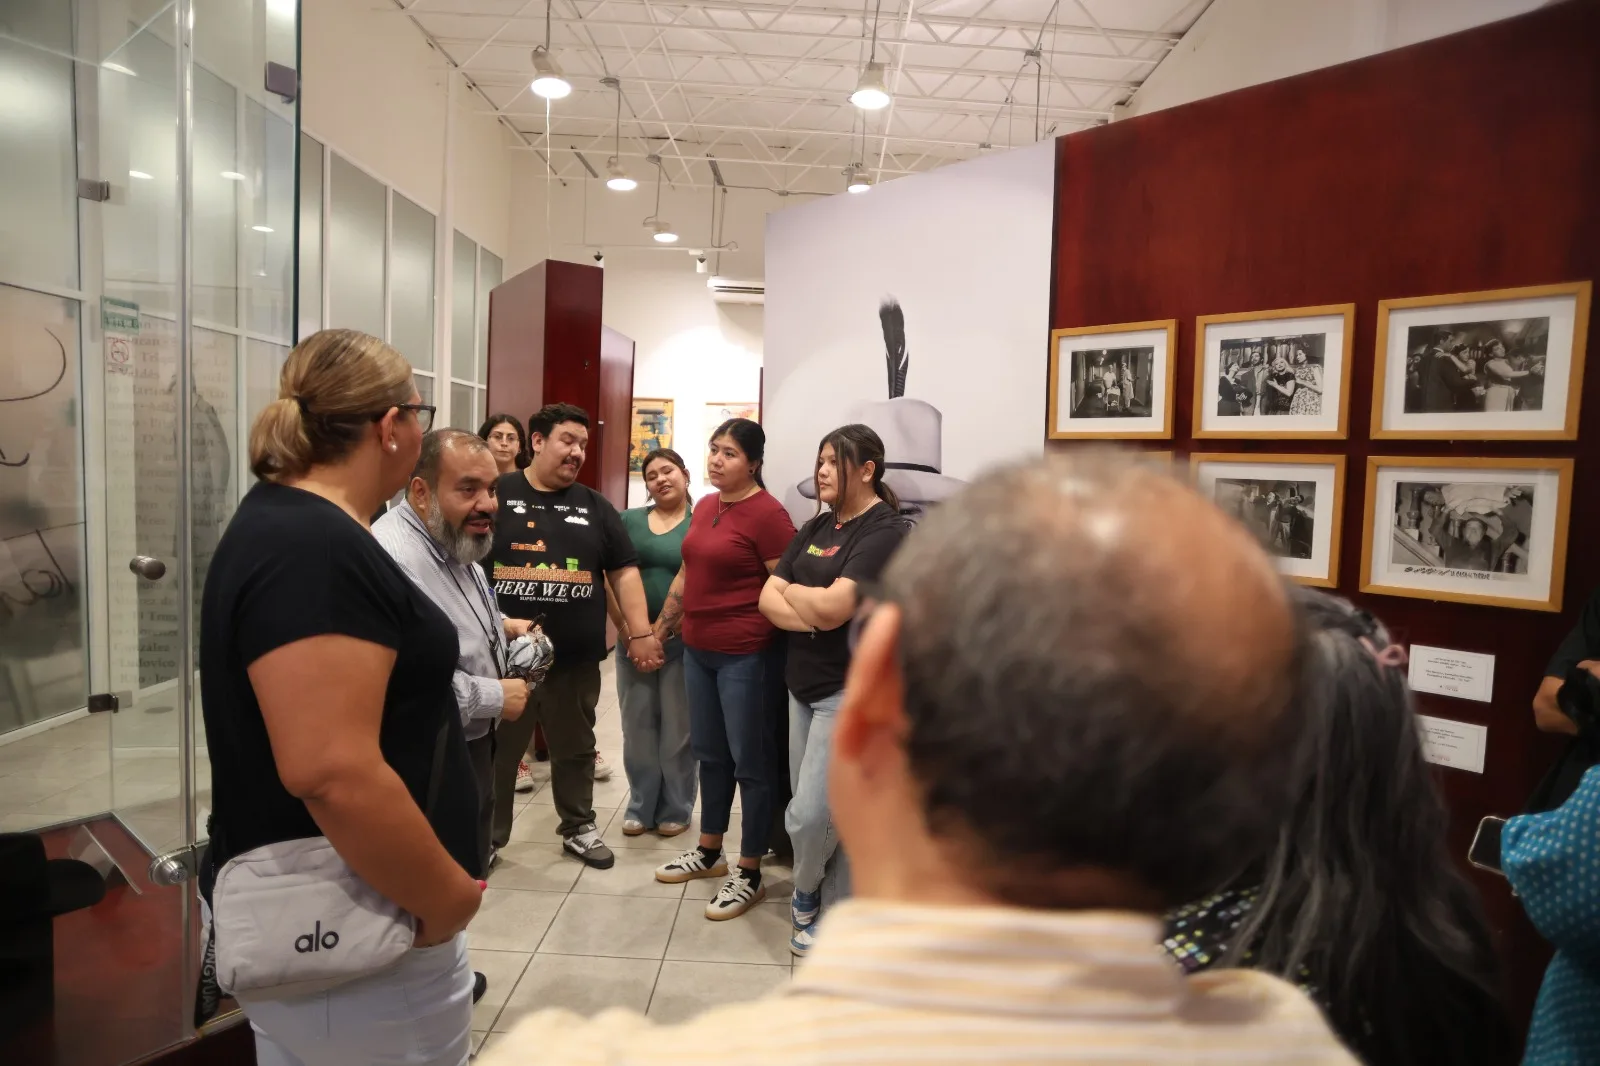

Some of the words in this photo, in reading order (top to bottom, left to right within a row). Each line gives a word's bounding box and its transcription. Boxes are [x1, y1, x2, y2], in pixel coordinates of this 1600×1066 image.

[494, 580, 538, 596] HERE
[541, 582, 569, 598] WE
[571, 584, 593, 598] GO!
[120, 657, 176, 668] Ludovico
[294, 920, 339, 953] alo
